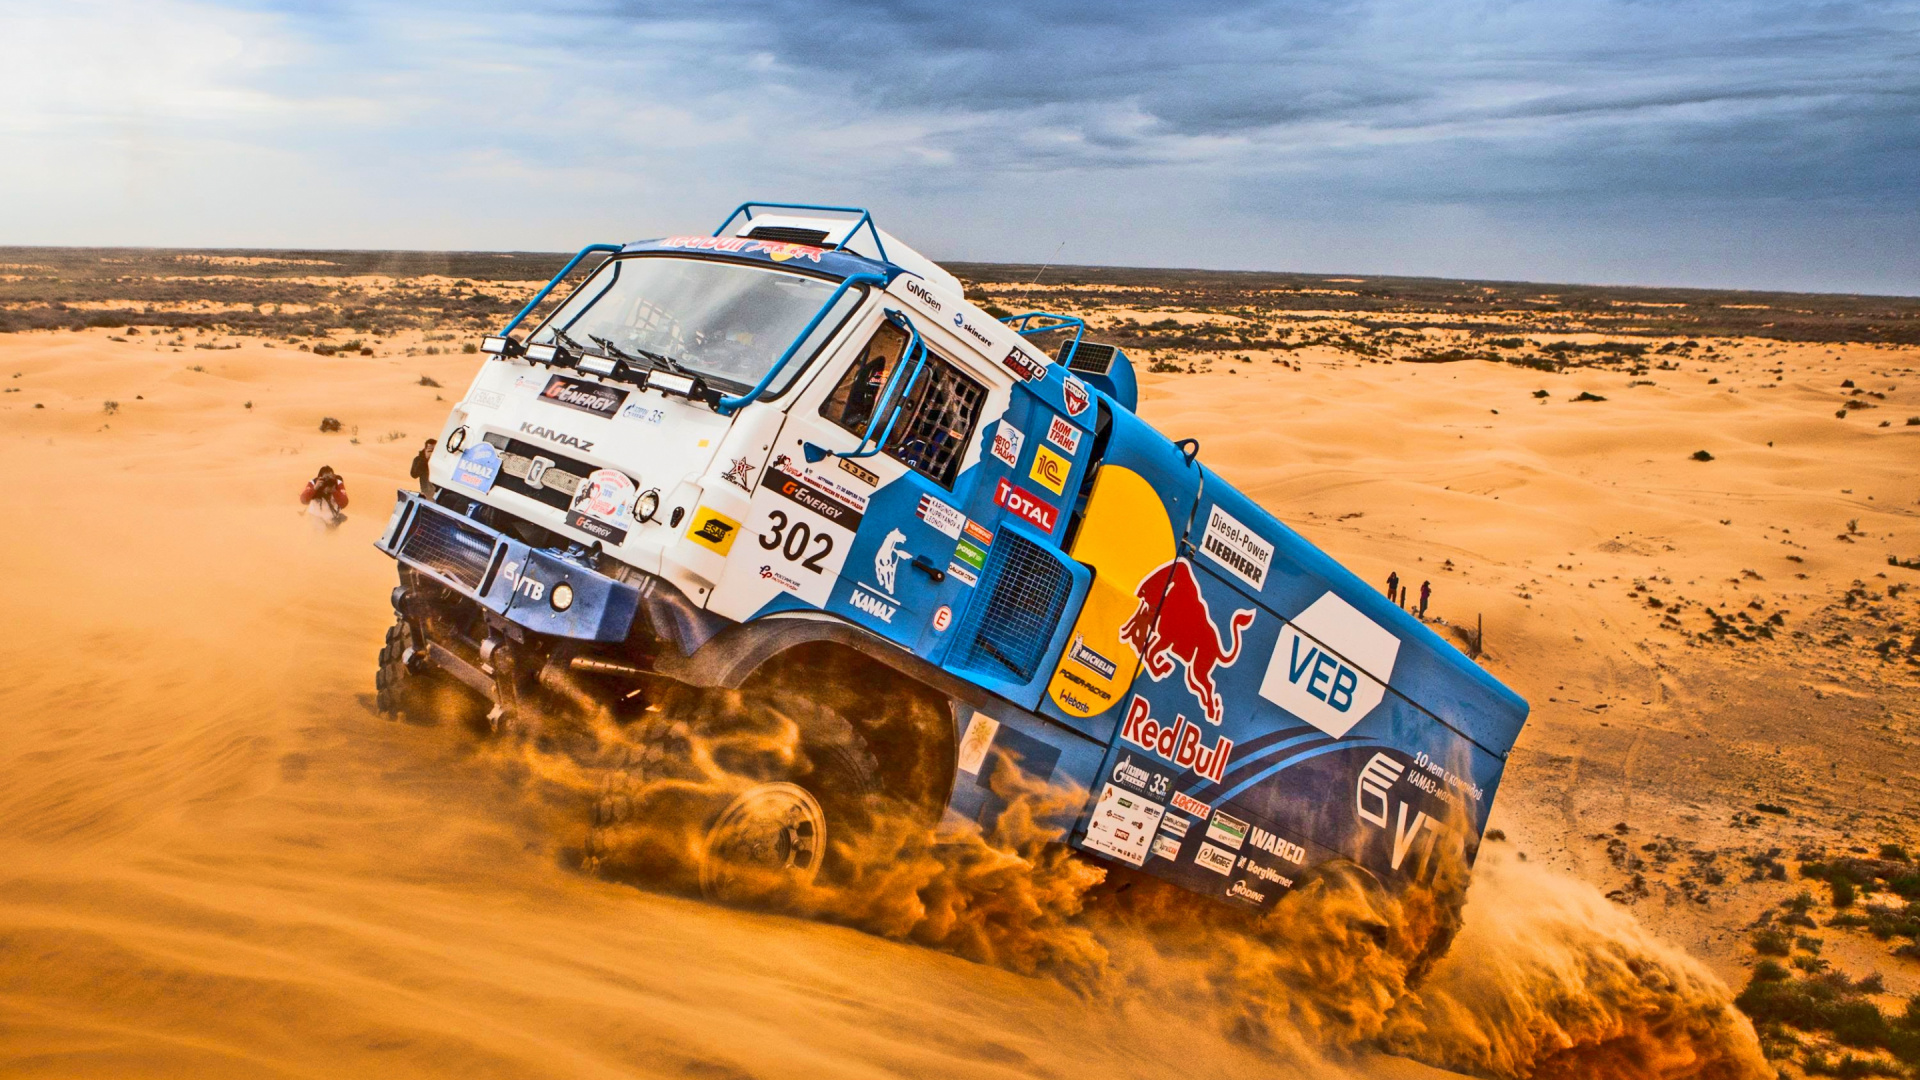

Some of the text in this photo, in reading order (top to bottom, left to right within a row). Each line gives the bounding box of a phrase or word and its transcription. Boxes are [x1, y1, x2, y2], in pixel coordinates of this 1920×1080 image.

[906, 280, 942, 311] GMGen
[964, 323, 992, 347] skincare
[1009, 349, 1047, 377] АВТО
[519, 421, 594, 452] KAMAZ
[1049, 428, 1075, 451] ТРАНС
[1053, 419, 1073, 436] КОМ
[994, 446, 1016, 465] РАДИО
[458, 460, 493, 479] KAMAZ
[1000, 483, 1052, 529] TOTAL
[703, 523, 726, 539] ESAB
[758, 510, 834, 575] 302
[1211, 512, 1269, 562] Diesel-Power
[1204, 534, 1263, 584] LIEBHERR
[512, 573, 545, 601] VTB
[849, 589, 896, 624] KAMAZ
[1079, 649, 1115, 675] MICHELIN
[1288, 634, 1358, 713] VEB
[1059, 688, 1090, 714] Webasto
[1121, 695, 1232, 783] Red Bull
[1126, 764, 1150, 782] ГАЗПРОМ
[1413, 751, 1429, 768] 10
[1426, 762, 1444, 777] лет
[1150, 773, 1170, 796] 35
[1171, 793, 1209, 818] LOCTITE
[1249, 826, 1305, 865] WABCO
[1246, 859, 1294, 888] BorgWarner
[1231, 884, 1265, 903] MODINE
